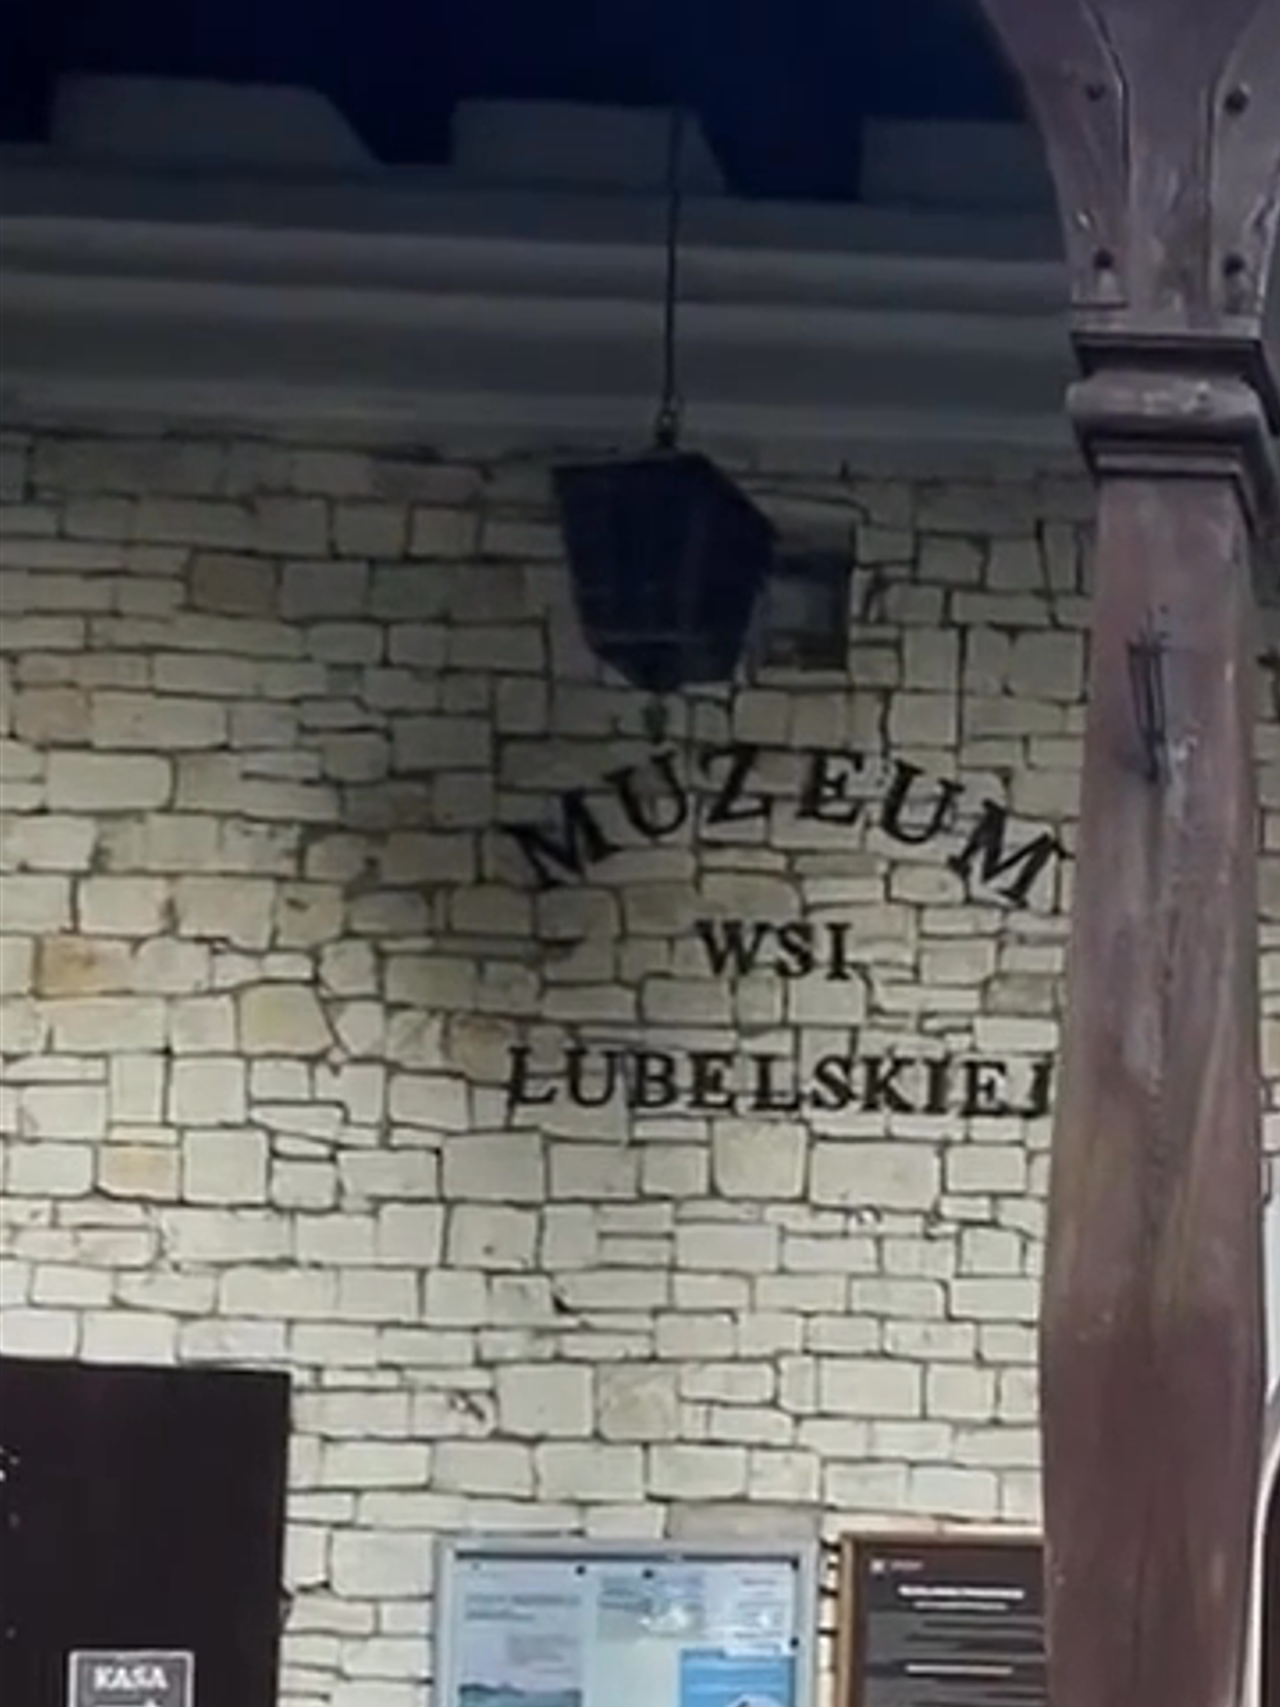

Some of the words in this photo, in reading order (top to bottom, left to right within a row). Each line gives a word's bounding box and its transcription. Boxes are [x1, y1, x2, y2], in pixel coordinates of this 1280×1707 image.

[505, 741, 1074, 906] MUZEUM
[696, 919, 853, 981] WSI
[507, 1046, 1053, 1119] LUBELSKIEJ
[94, 1666, 168, 1690] KASA
